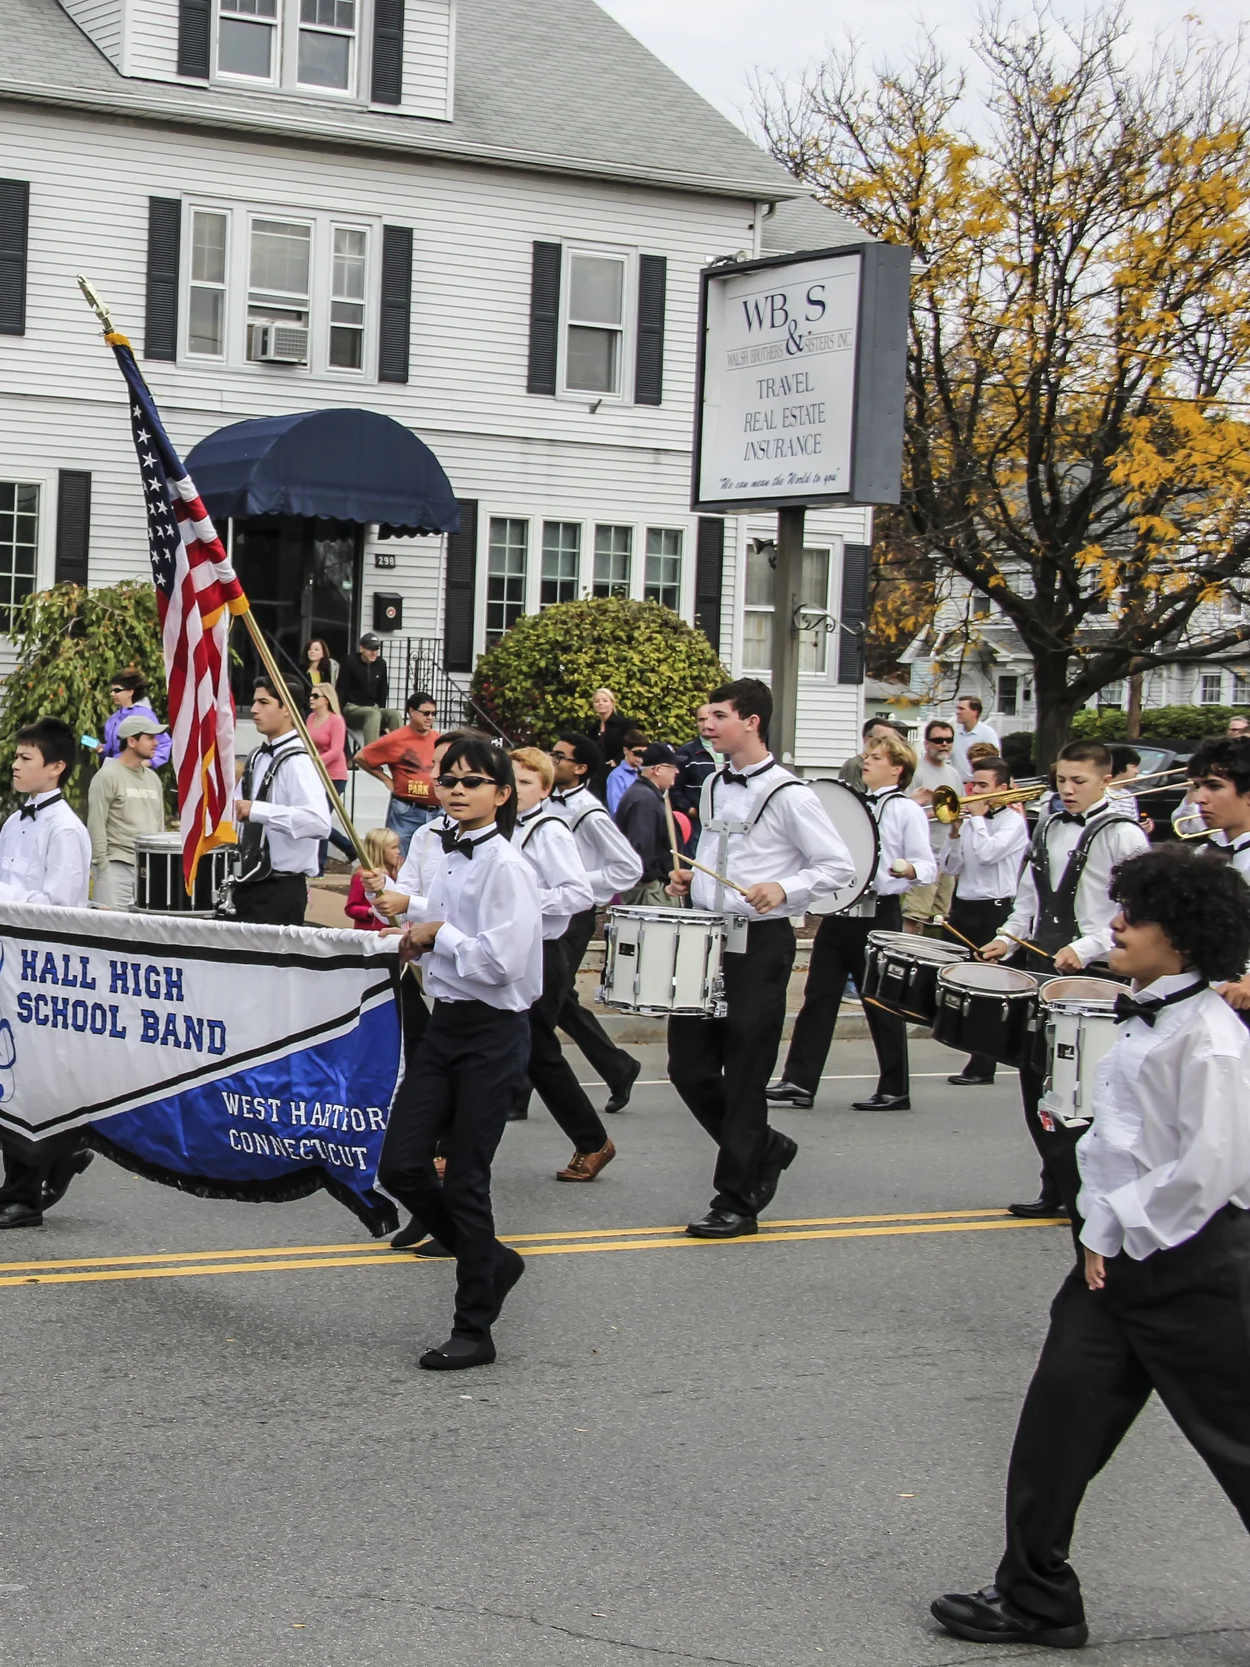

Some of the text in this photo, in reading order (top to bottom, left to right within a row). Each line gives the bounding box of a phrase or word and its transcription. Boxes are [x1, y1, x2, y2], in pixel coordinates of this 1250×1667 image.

[742, 284, 826, 355] WB & S
[750, 343, 784, 365] BROTHERS
[804, 334, 835, 353] SISTERS
[756, 371, 815, 400] TRAVEL
[743, 402, 826, 433] REAL ESTATE
[743, 433, 822, 461] INSURANCE
[735, 481, 748, 489] can
[750, 479, 769, 488] mean
[771, 473, 784, 487] the
[787, 471, 811, 485] World
[812, 473, 821, 484] to
[378, 556, 395, 566] 298
[407, 784, 429, 796] PARK
[20, 949, 184, 1002] HALL HIGH
[16, 991, 227, 1056] SCHOOL BAND
[221, 1091, 392, 1133] WEST HARTFOR
[228, 1128, 368, 1171] CONNECTICUT
